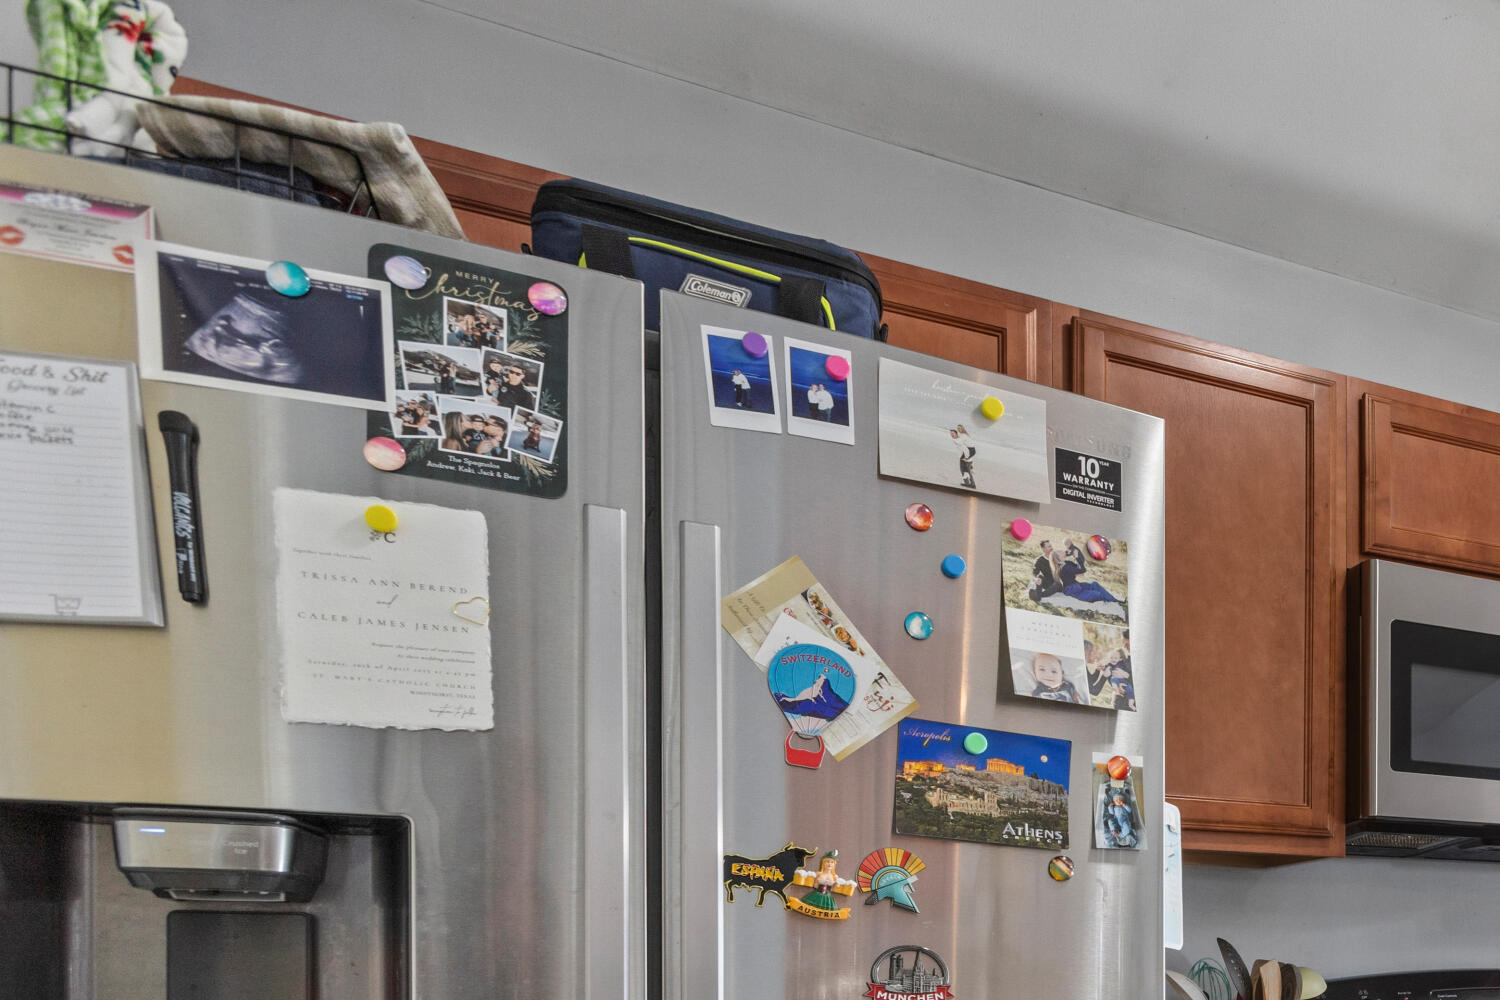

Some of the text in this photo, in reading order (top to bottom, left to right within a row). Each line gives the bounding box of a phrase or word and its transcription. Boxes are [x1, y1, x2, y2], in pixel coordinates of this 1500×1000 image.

[455, 270, 495, 284] MERRY
[690, 280, 732, 300] Coleman
[0, 364, 38, 377] ood
[62, 366, 110, 383] Shit
[448, 455, 462, 463] The
[1078, 456, 1100, 479] 10
[1063, 472, 1115, 491] WARRANTY
[1063, 488, 1087, 499] DIGITAL
[1087, 493, 1115, 505] INVERTER
[384, 532, 397, 543] C
[369, 578, 400, 588] ANN
[410, 582, 469, 594] BEREND
[297, 611, 470, 634] CALEB JAMES JENSEN
[780, 653, 852, 678] SWITZERLAND
[903, 727, 952, 747] Acropolis
[798, 905, 841, 919] AUSTRIA
